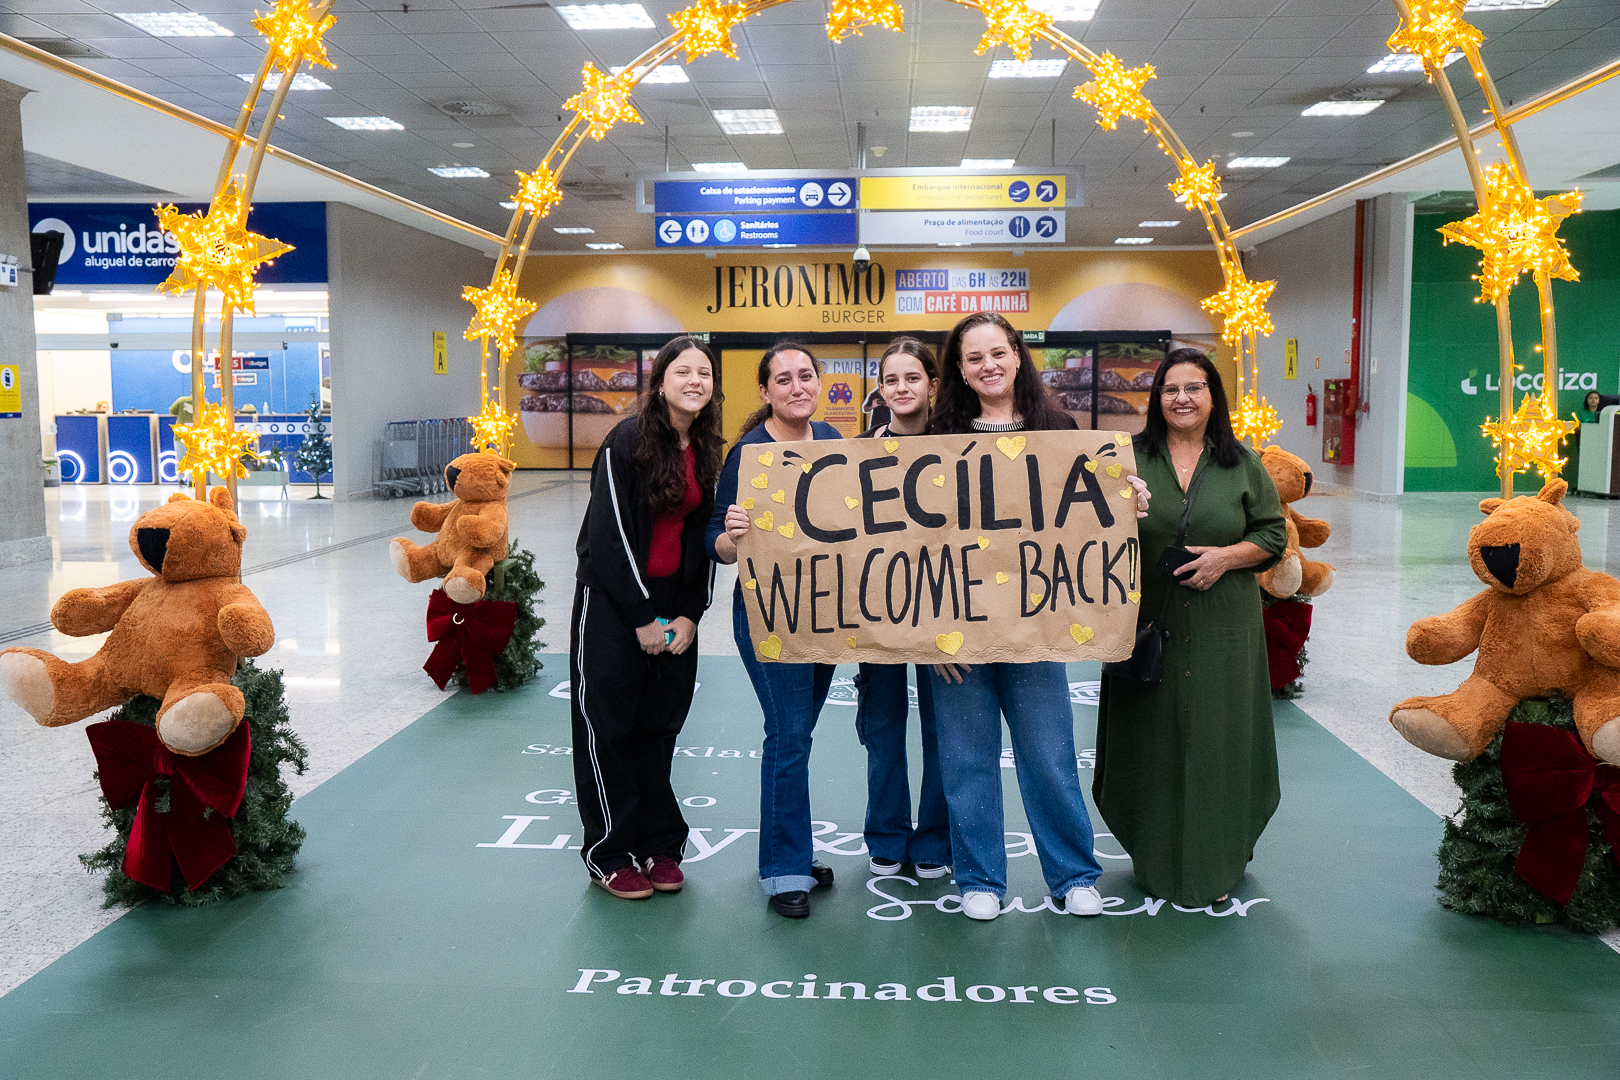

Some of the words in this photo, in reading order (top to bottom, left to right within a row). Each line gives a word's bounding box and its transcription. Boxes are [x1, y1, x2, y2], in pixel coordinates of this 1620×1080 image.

[700, 186, 721, 195] Caixa
[723, 186, 733, 195] de
[733, 186, 796, 195] estacionamento
[912, 183, 951, 191] Embarque
[952, 183, 1003, 191] internacional
[734, 196, 762, 206] Parking
[762, 196, 796, 206] payment
[917, 193, 963, 201] International
[964, 193, 1003, 202] departures
[740, 221, 779, 230] Sanitários
[924, 219, 945, 228] Praça
[957, 218, 1003, 228] alimentação
[83, 223, 181, 255] unidas
[740, 231, 779, 239] Restrooms
[965, 228, 983, 236] Food
[984, 228, 1004, 236] court
[84, 255, 126, 270] aluguel
[127, 255, 143, 267] de
[144, 257, 179, 267] carros
[898, 272, 946, 288] ABERTO
[952, 277, 967, 288] DAS
[969, 272, 986, 288] 6H
[1000, 271, 1027, 288] 22H
[706, 262, 886, 314] JERONIMO
[898, 296, 923, 312] COM
[926, 293, 957, 312] CAFÉ
[960, 295, 978, 312] DA
[980, 292, 1028, 311] MANHÃ
[822, 310, 886, 324] BURGER
[438, 351, 444, 371] A
[1287, 356, 1294, 376] A
[794, 440, 1115, 544] CECÍLIA
[746, 543, 988, 635] WELCOME
[1019, 537, 1142, 618] BACK!
[566, 968, 1118, 1005] Patrocinadores
